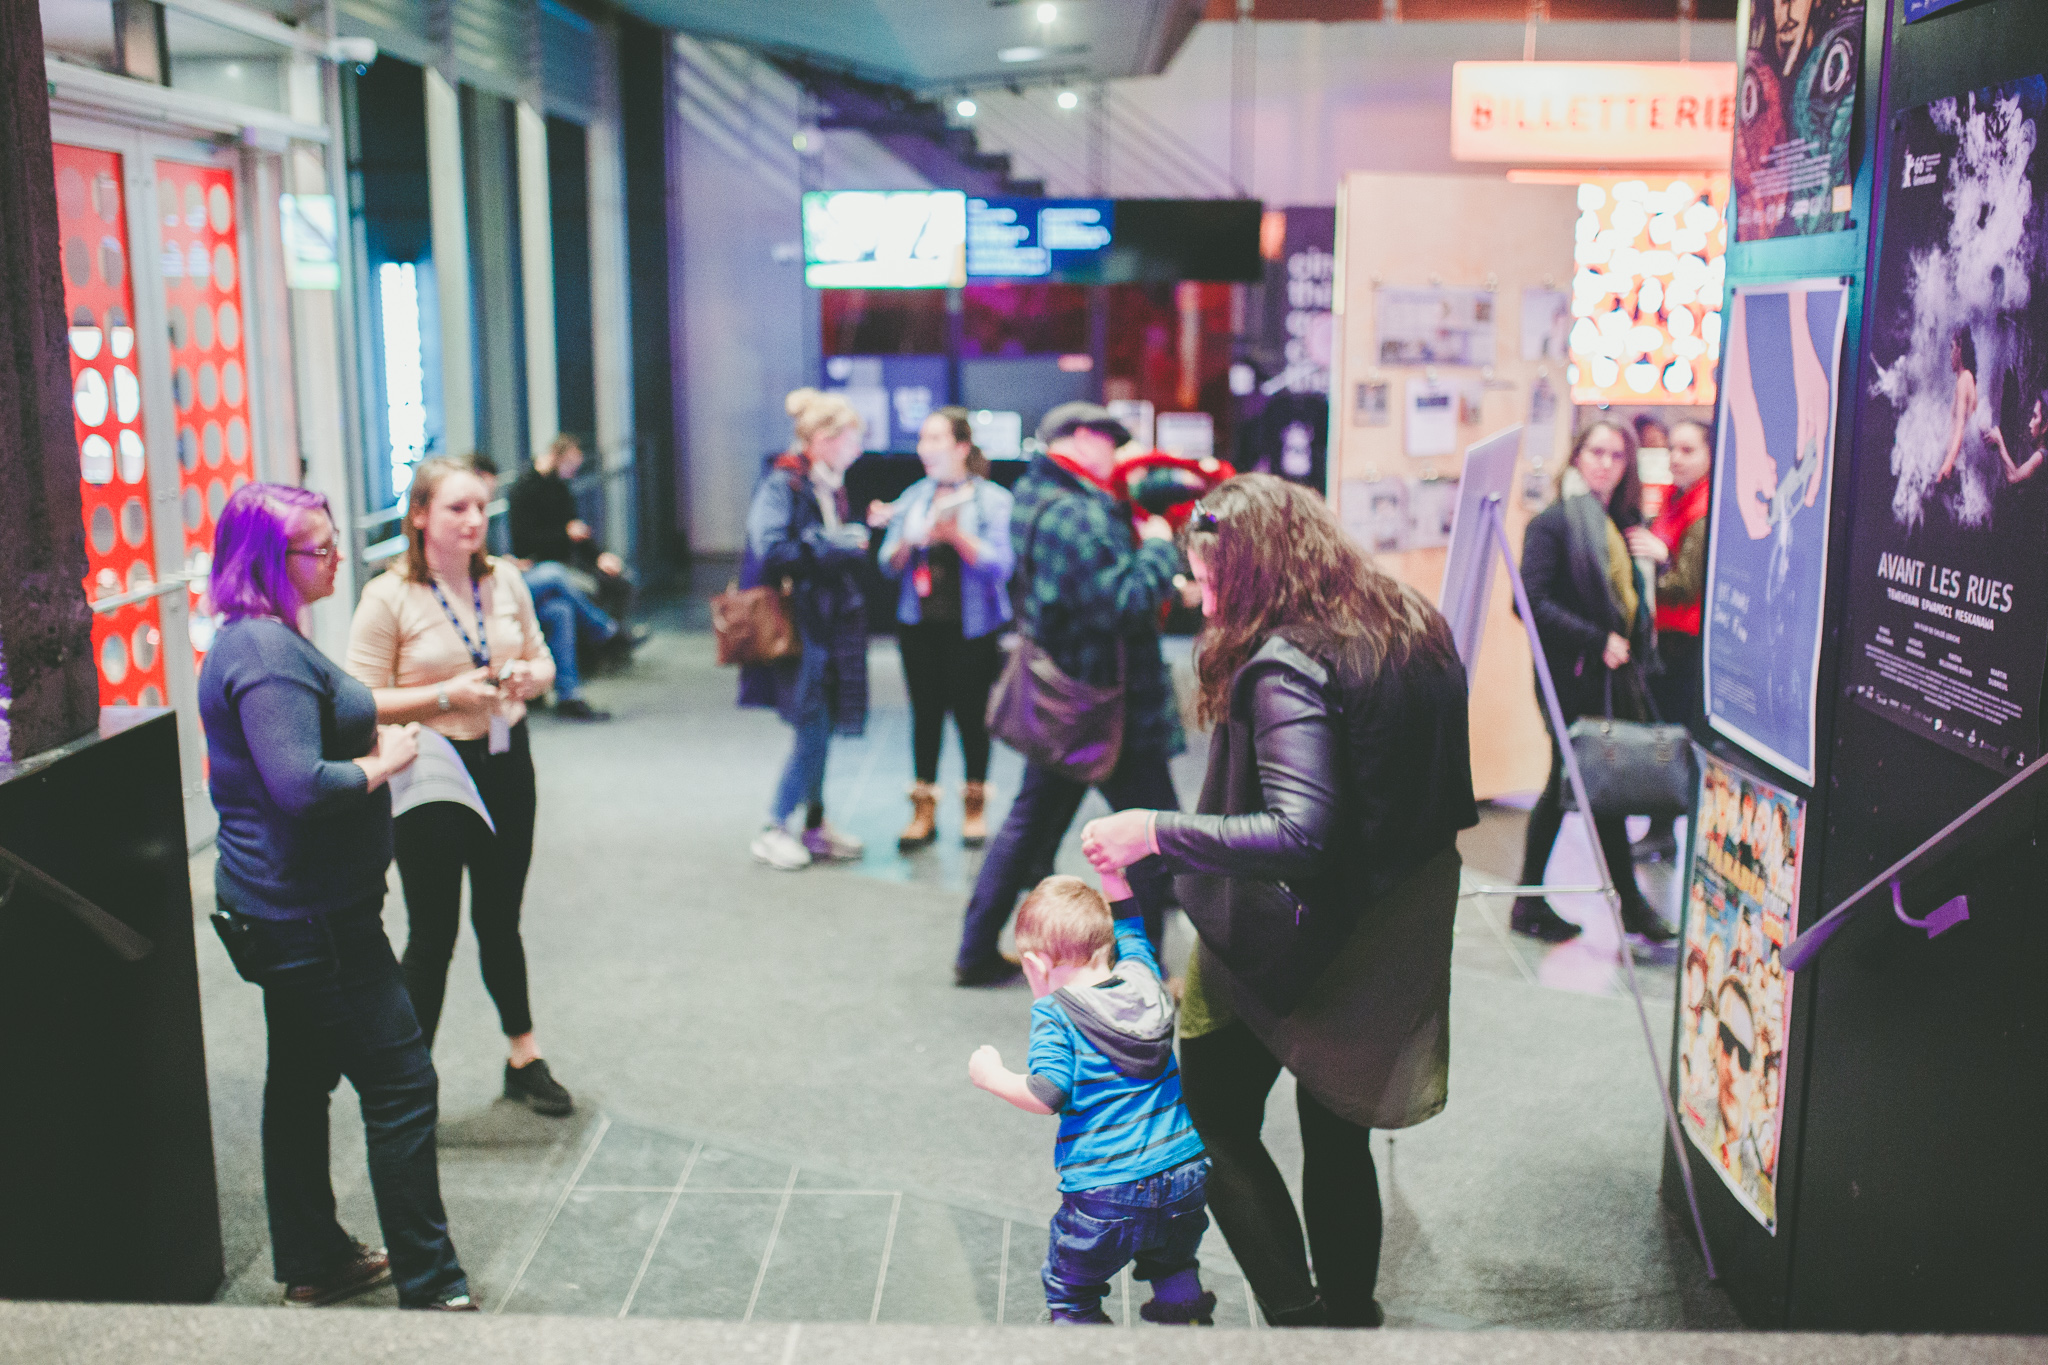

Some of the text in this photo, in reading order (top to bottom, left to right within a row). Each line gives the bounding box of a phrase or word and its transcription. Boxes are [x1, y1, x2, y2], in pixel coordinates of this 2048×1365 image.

[1470, 94, 1735, 131] BILLETTERIE
[1877, 551, 2014, 613] AVANT LES RUES
